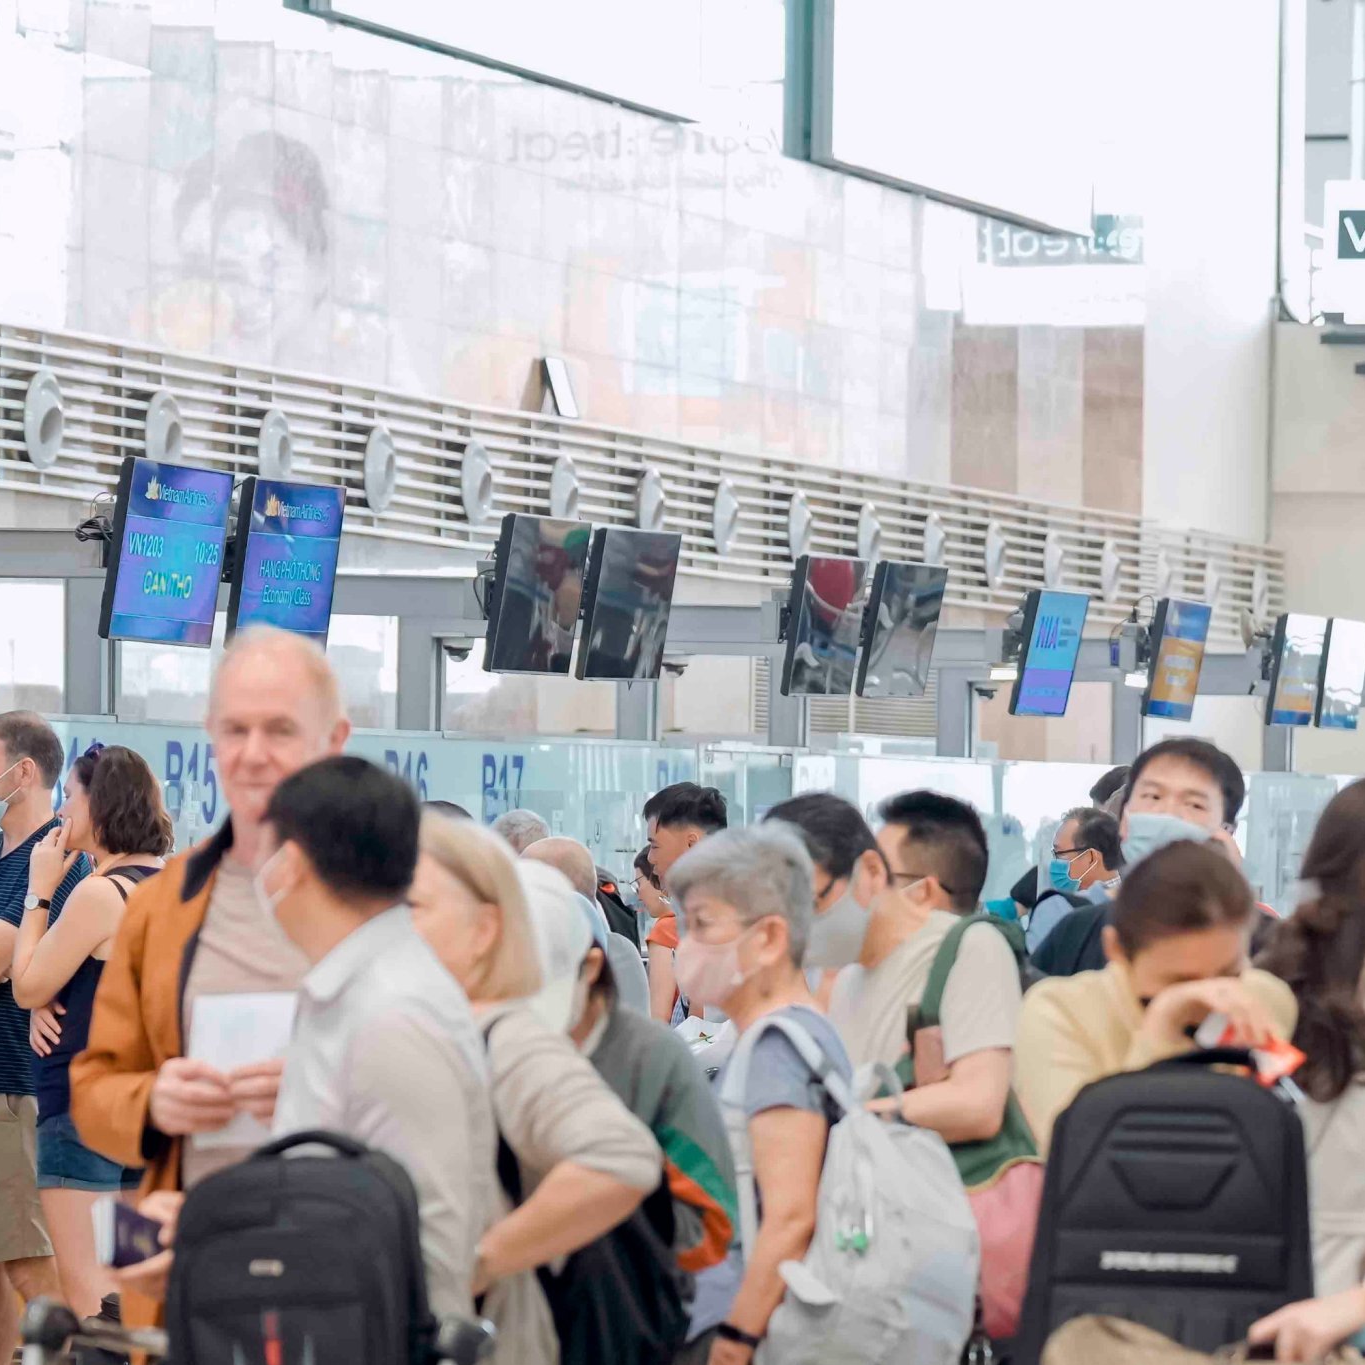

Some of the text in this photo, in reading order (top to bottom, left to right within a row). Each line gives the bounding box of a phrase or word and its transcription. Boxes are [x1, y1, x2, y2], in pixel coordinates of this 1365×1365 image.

[128, 532, 220, 565] VN1203 10:25
[262, 584, 311, 609] Economy Class
